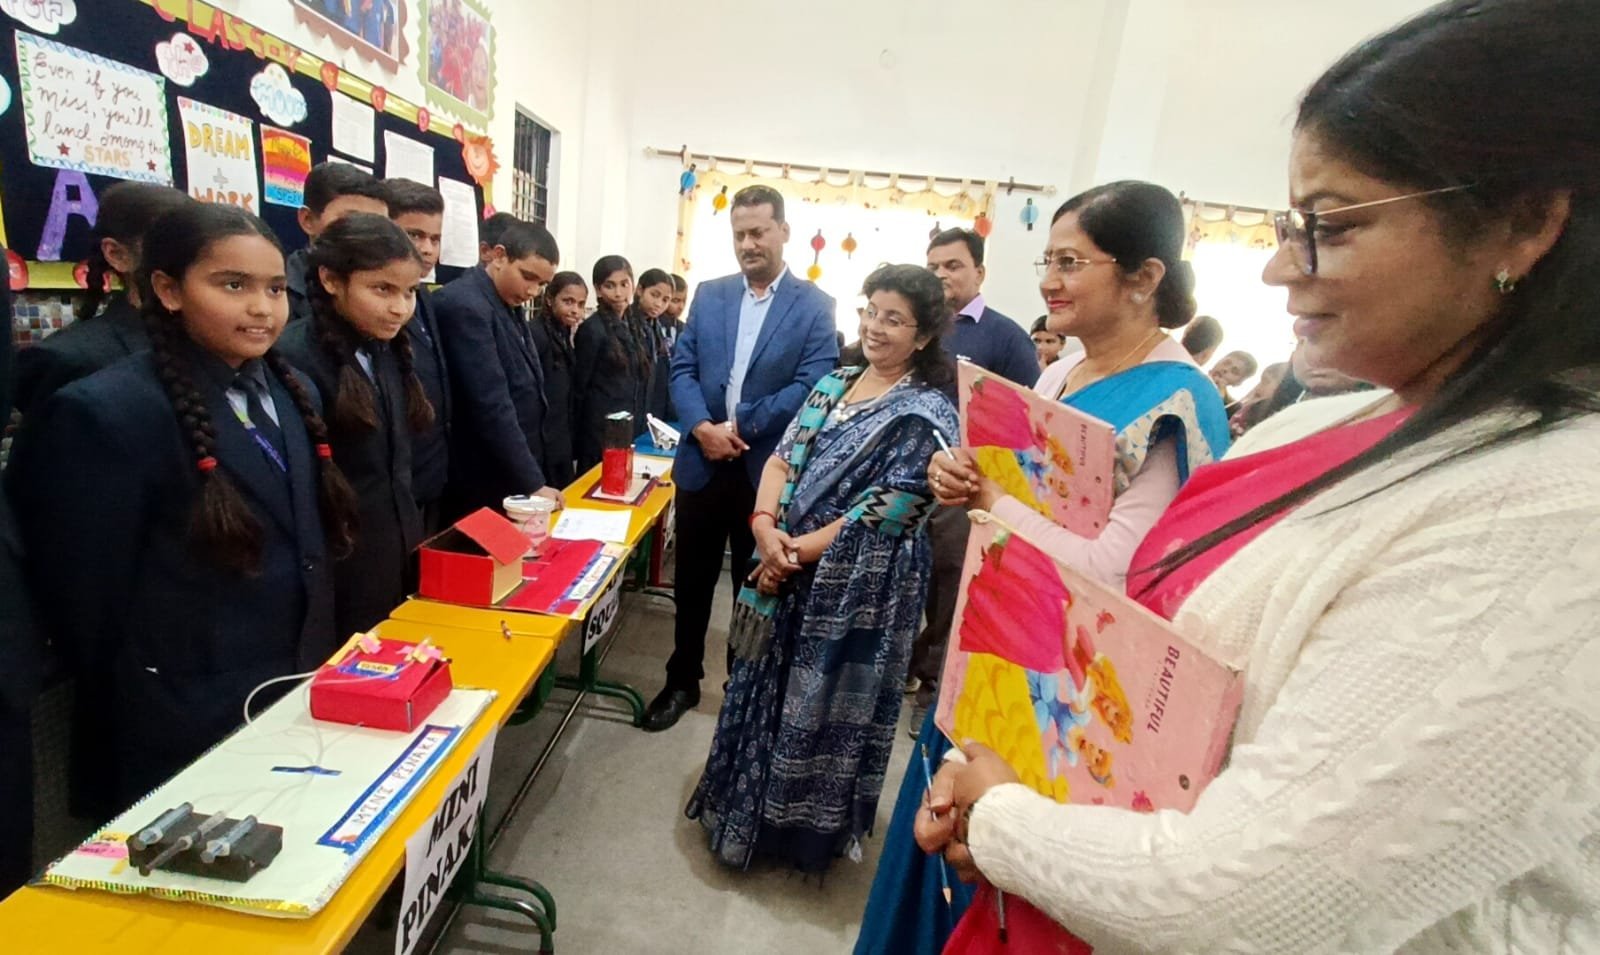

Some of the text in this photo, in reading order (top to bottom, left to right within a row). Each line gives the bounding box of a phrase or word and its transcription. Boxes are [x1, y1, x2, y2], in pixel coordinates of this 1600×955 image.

[33, 52, 141, 105] Even if you
[38, 86, 153, 130] miss, you'll
[42, 111, 163, 158] land among the
[84, 145, 131, 167] STARS
[187, 120, 250, 161] DREAM
[1147, 645, 1180, 733] BEAUTIFUL
[351, 736, 438, 825] MINI PINAKA
[426, 756, 480, 858] MINI
